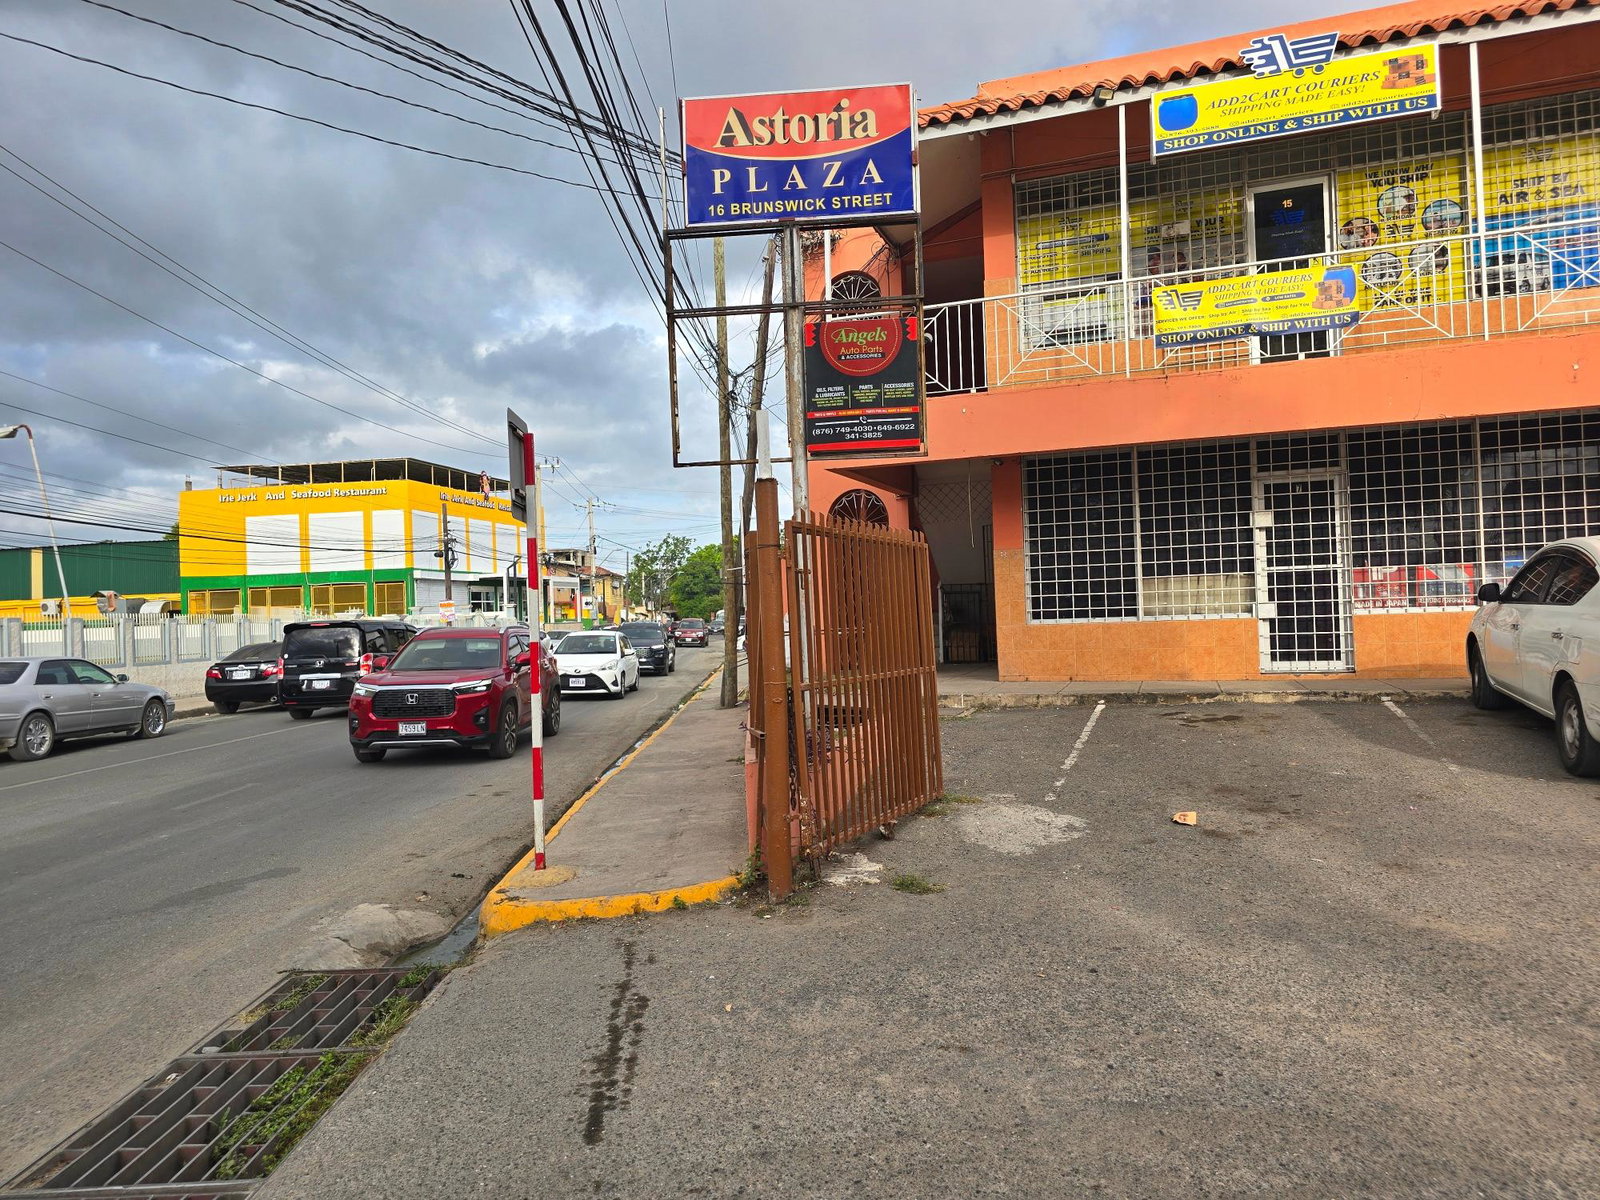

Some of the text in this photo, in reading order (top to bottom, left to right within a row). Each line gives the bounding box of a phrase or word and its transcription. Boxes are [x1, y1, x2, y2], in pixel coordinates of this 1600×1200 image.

[1206, 70, 1381, 110] ADD2CART COURIERS
[1220, 85, 1366, 117] SHIPPING MADE EASY!
[712, 97, 879, 148] Astoria
[1163, 97, 1428, 150] SHOP ONLINE & SHIP WITH US
[712, 158, 884, 195] PLAZA
[1365, 163, 1433, 179] WE KNOW WHY
[1372, 172, 1429, 188] YOU SHIP
[1513, 173, 1570, 189] SHIP BY
[1282, 199, 1293, 208] 15
[1499, 185, 1584, 205] AIR & SEA
[708, 193, 893, 217] 16 BRUNSWICK STREET
[1195, 216, 1225, 227] YOUR
[1206, 273, 1313, 295] ADD2CART COURIERS
[1214, 283, 1304, 301] SHIPPING MADE EASY!
[831, 326, 887, 346] Angels
[1161, 314, 1351, 344] SHOP ONLINE & SHIP WITH US
[840, 345, 883, 355] Auto Parts
[812, 423, 915, 436] (876) 749-4030 649-6922
[845, 431, 883, 440] 341-3825
[219, 487, 387, 503] Irie Jerk And Seafood Restaurant
[1354, 599, 1407, 608] MADE IN JAPAN
